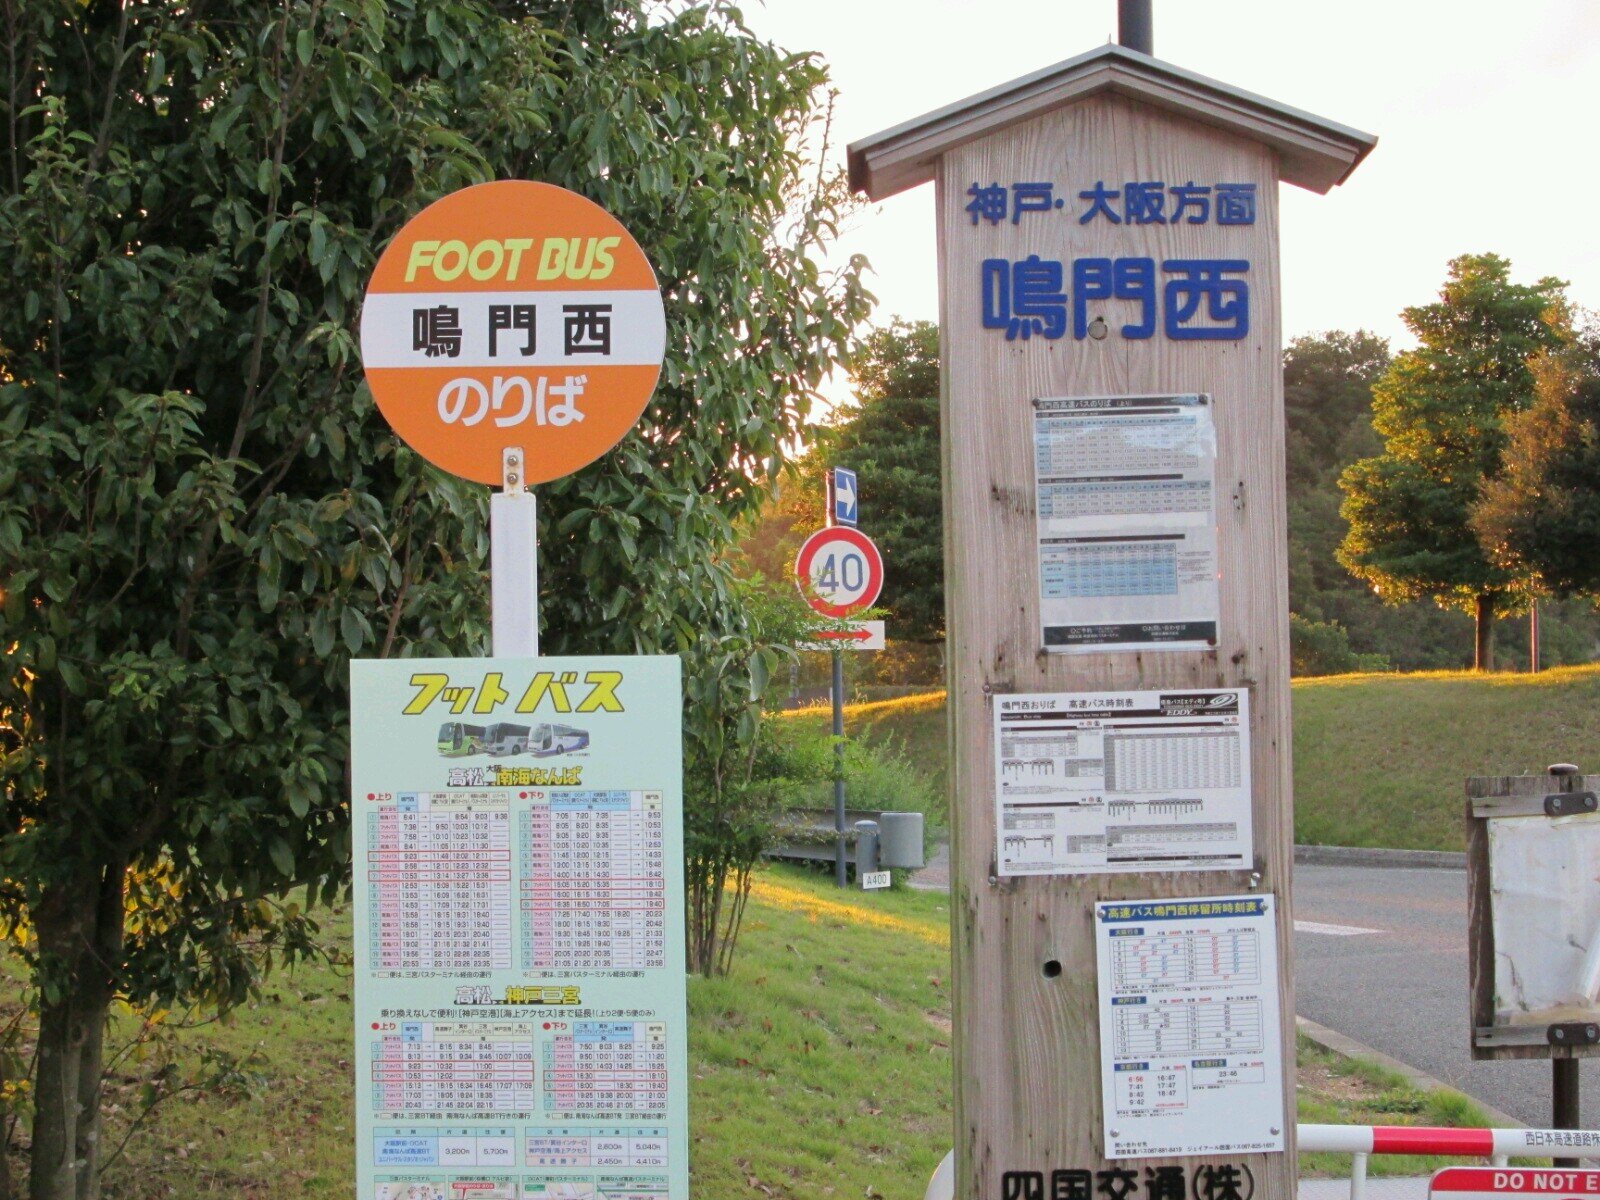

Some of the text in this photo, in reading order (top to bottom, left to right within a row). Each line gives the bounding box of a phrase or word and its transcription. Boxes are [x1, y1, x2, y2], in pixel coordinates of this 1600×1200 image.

[966, 180, 1257, 226] 神戸・大阪方面
[404, 236, 621, 282] FOOT BUS
[982, 254, 1250, 341] 鳴門西
[412, 304, 613, 358] 鳴門西
[437, 374, 588, 428] のりば
[818, 552, 864, 594] 40
[449, 767, 484, 786] 高松
[496, 765, 583, 786] 南海なんば
[375, 793, 392, 801] 上り
[527, 791, 545, 799] 下り
[866, 874, 887, 885] A400
[1108, 901, 1257, 919] 高速バス鳴門西停留所時刻表
[455, 984, 581, 1005] 高松 神戸三宮
[380, 1023, 397, 1031] 上り
[551, 1022, 568, 1030] 下り
[1493, 1172, 1525, 1189] DO
[1533, 1173, 1578, 1190] NOT
